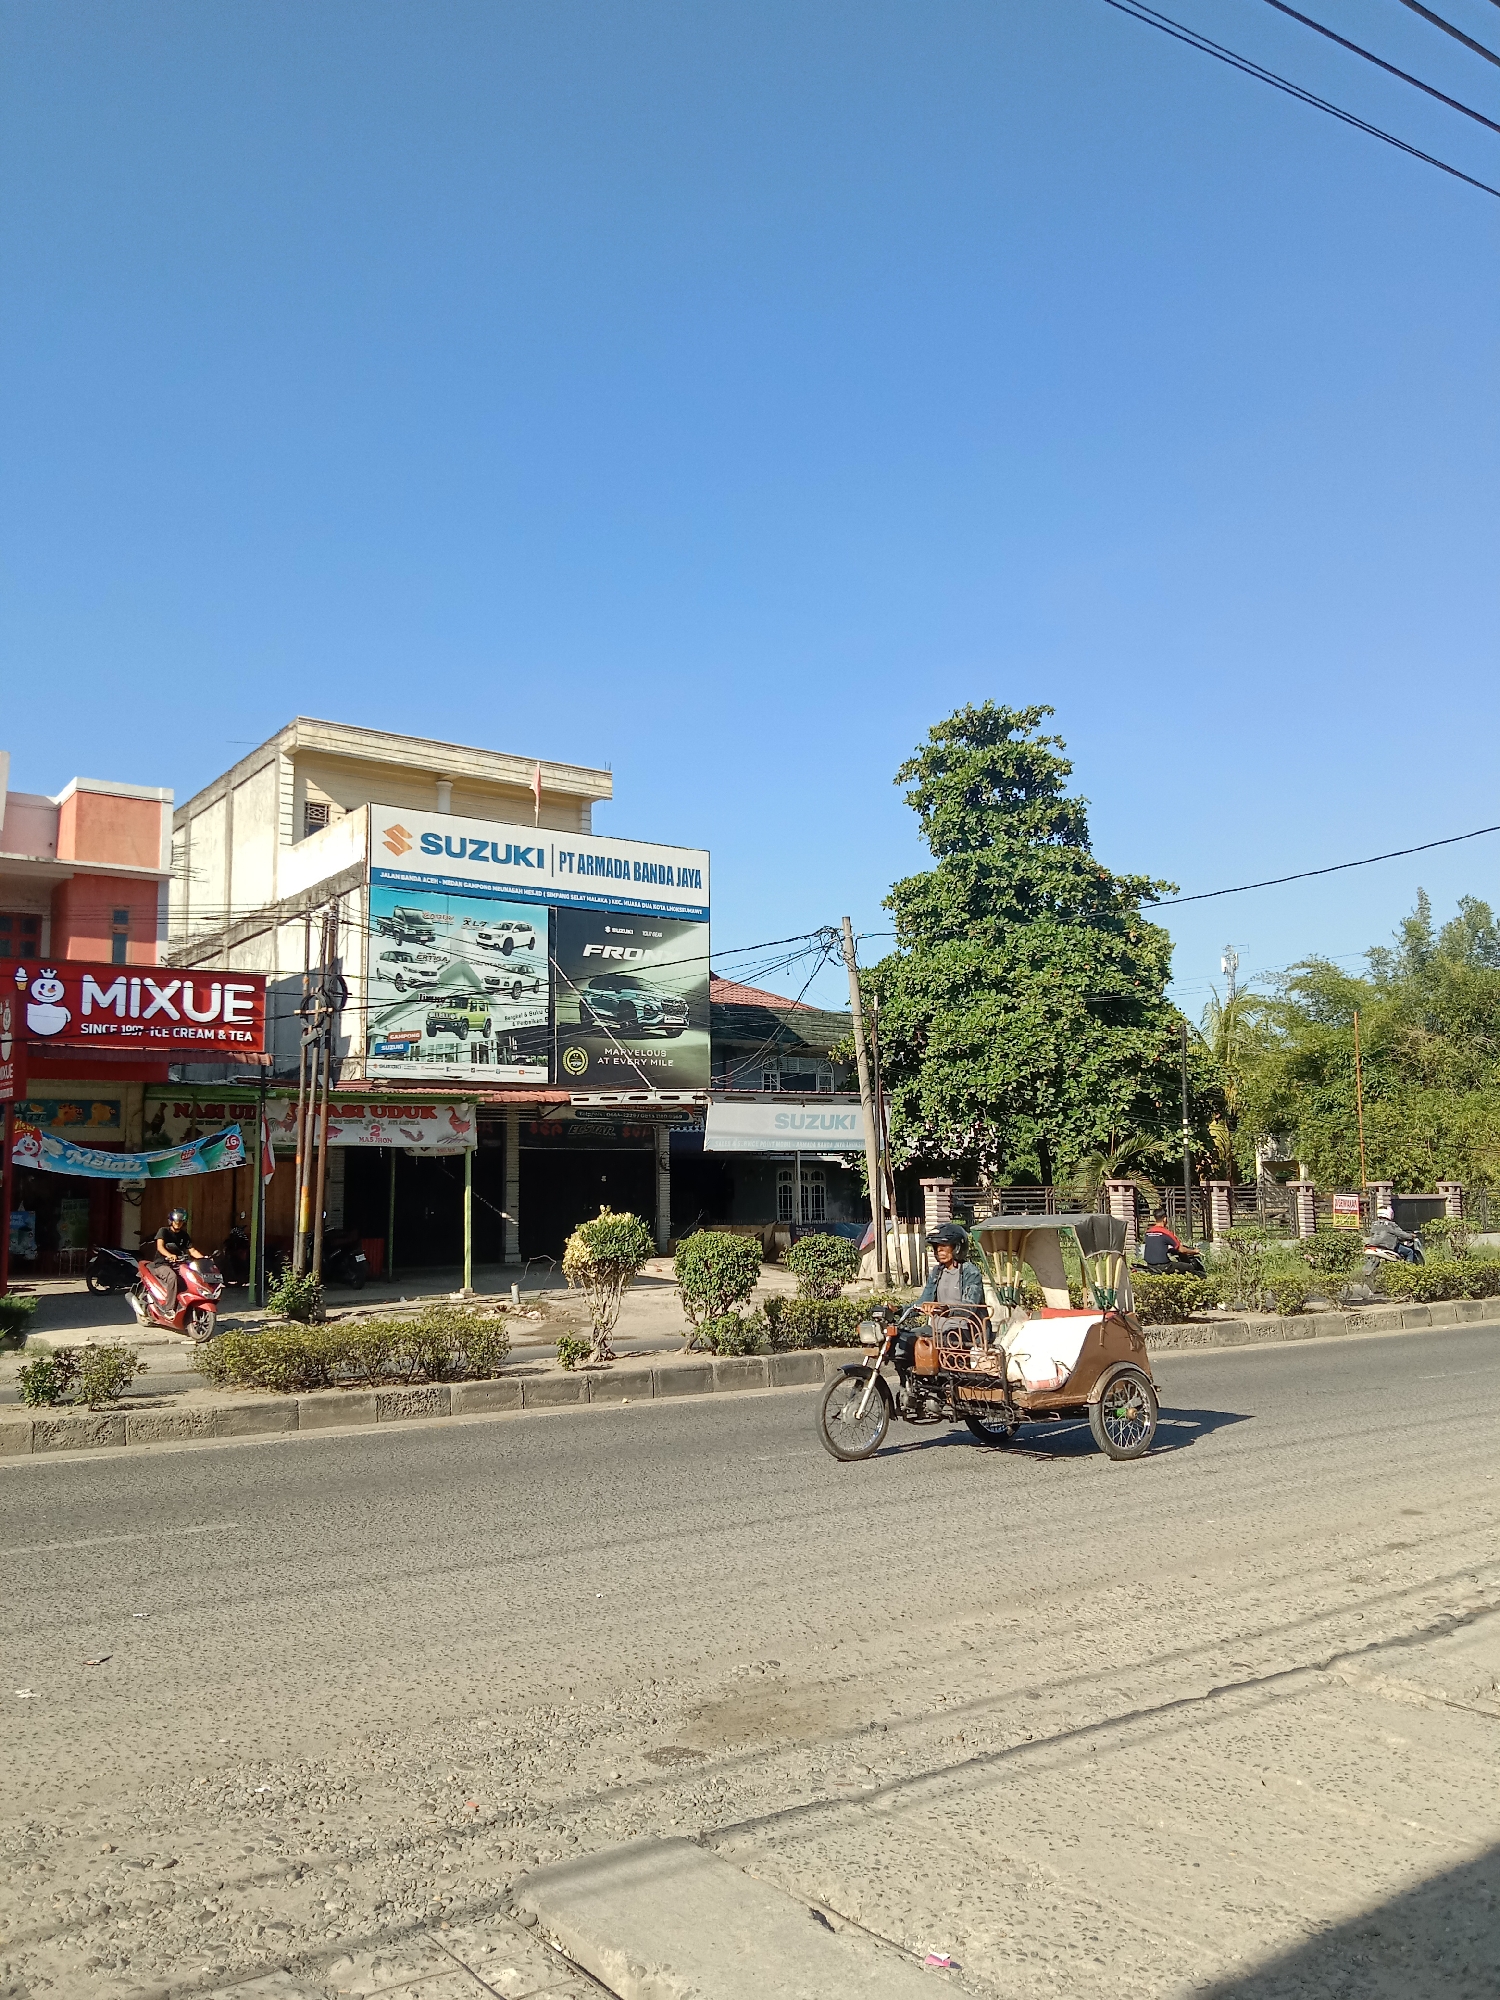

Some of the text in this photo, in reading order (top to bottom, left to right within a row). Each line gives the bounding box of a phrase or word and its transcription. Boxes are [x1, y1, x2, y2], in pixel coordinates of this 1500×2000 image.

[420, 832, 545, 870] SUZUKI
[379, 871, 400, 880] JALAN
[559, 850, 703, 890] PT ARMADA BANDA JAYA
[81, 974, 256, 1025] MIXUE
[173, 1029, 215, 1040] CREAM
[217, 1030, 227, 1040] &
[229, 1030, 253, 1042] TEA
[389, 1032, 421, 1040] GAMPONG
[381, 1043, 404, 1051] SUZUKI
[604, 1048, 667, 1058] MARVELOUS
[597, 1057, 674, 1067] AT EVERY MILE
[369, 1104, 437, 1119] UDUK
[774, 1112, 857, 1130] SUZUKI
[369, 1124, 381, 1137] 2
